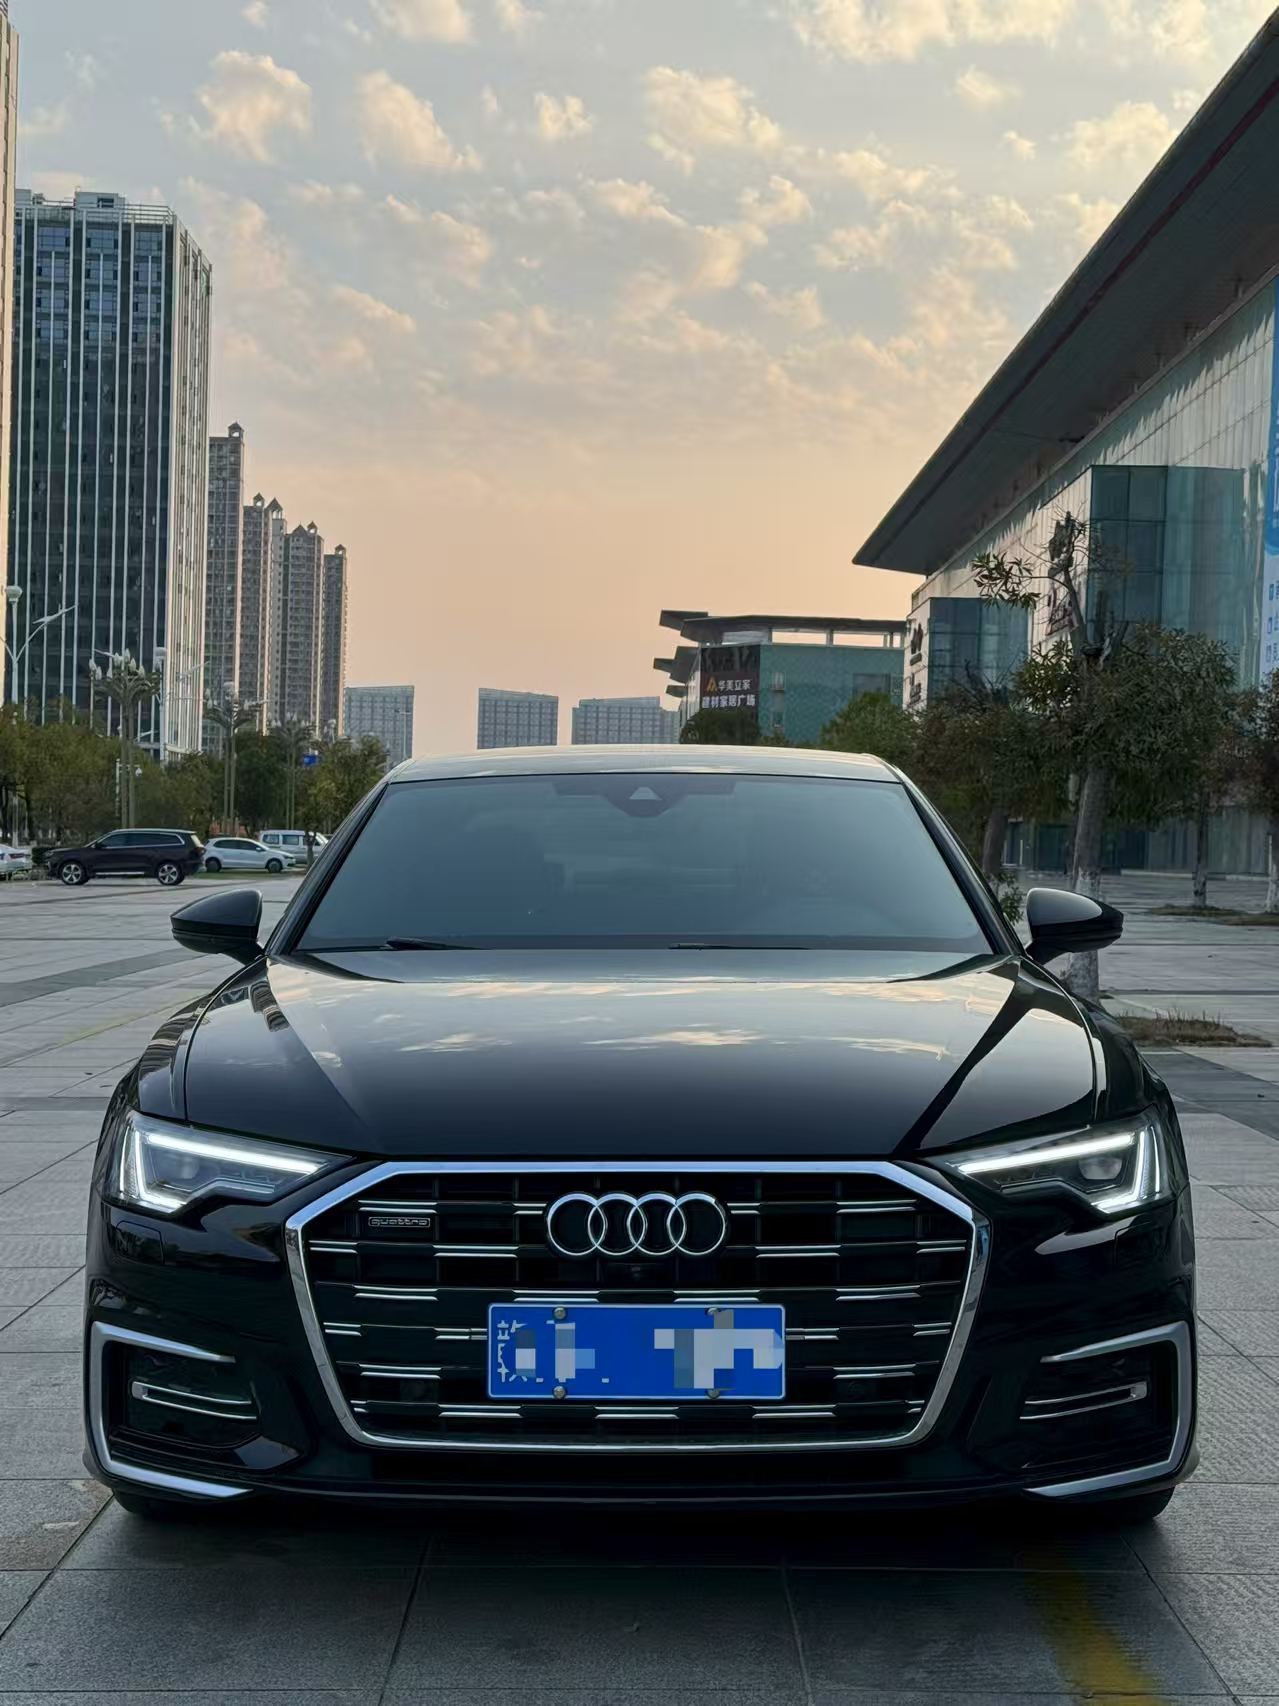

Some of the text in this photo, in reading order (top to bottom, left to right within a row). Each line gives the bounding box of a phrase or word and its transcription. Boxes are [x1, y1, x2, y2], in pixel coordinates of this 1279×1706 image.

[718, 679, 752, 691] 华美立家
[701, 694, 756, 708] 建材家居广场
[370, 1218, 428, 1227] quattro
